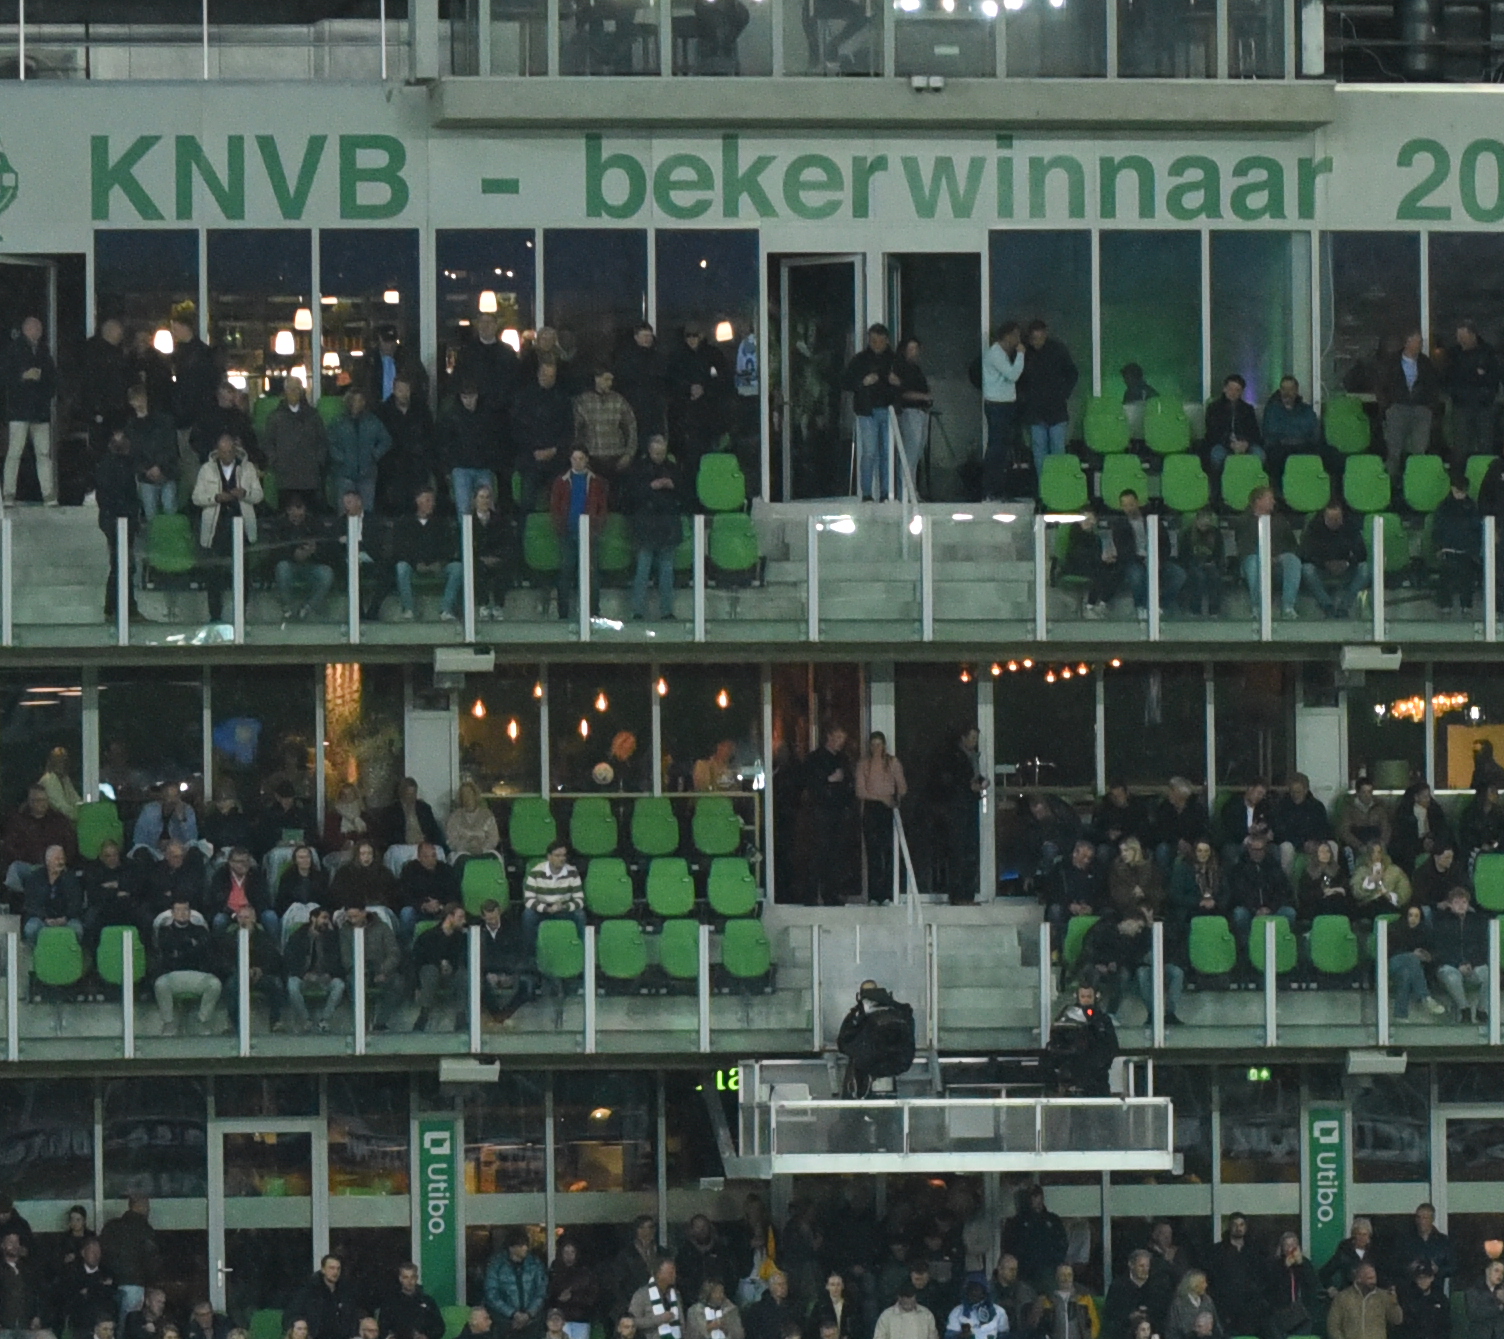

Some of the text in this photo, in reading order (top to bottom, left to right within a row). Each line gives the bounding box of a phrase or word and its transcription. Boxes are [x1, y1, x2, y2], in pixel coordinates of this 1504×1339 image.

[89, 134, 410, 221] KNVB
[585, 134, 1334, 221] bekerwinnaar
[427, 1163, 450, 1240] Utibo.
[1316, 1152, 1338, 1228] Utibo.
